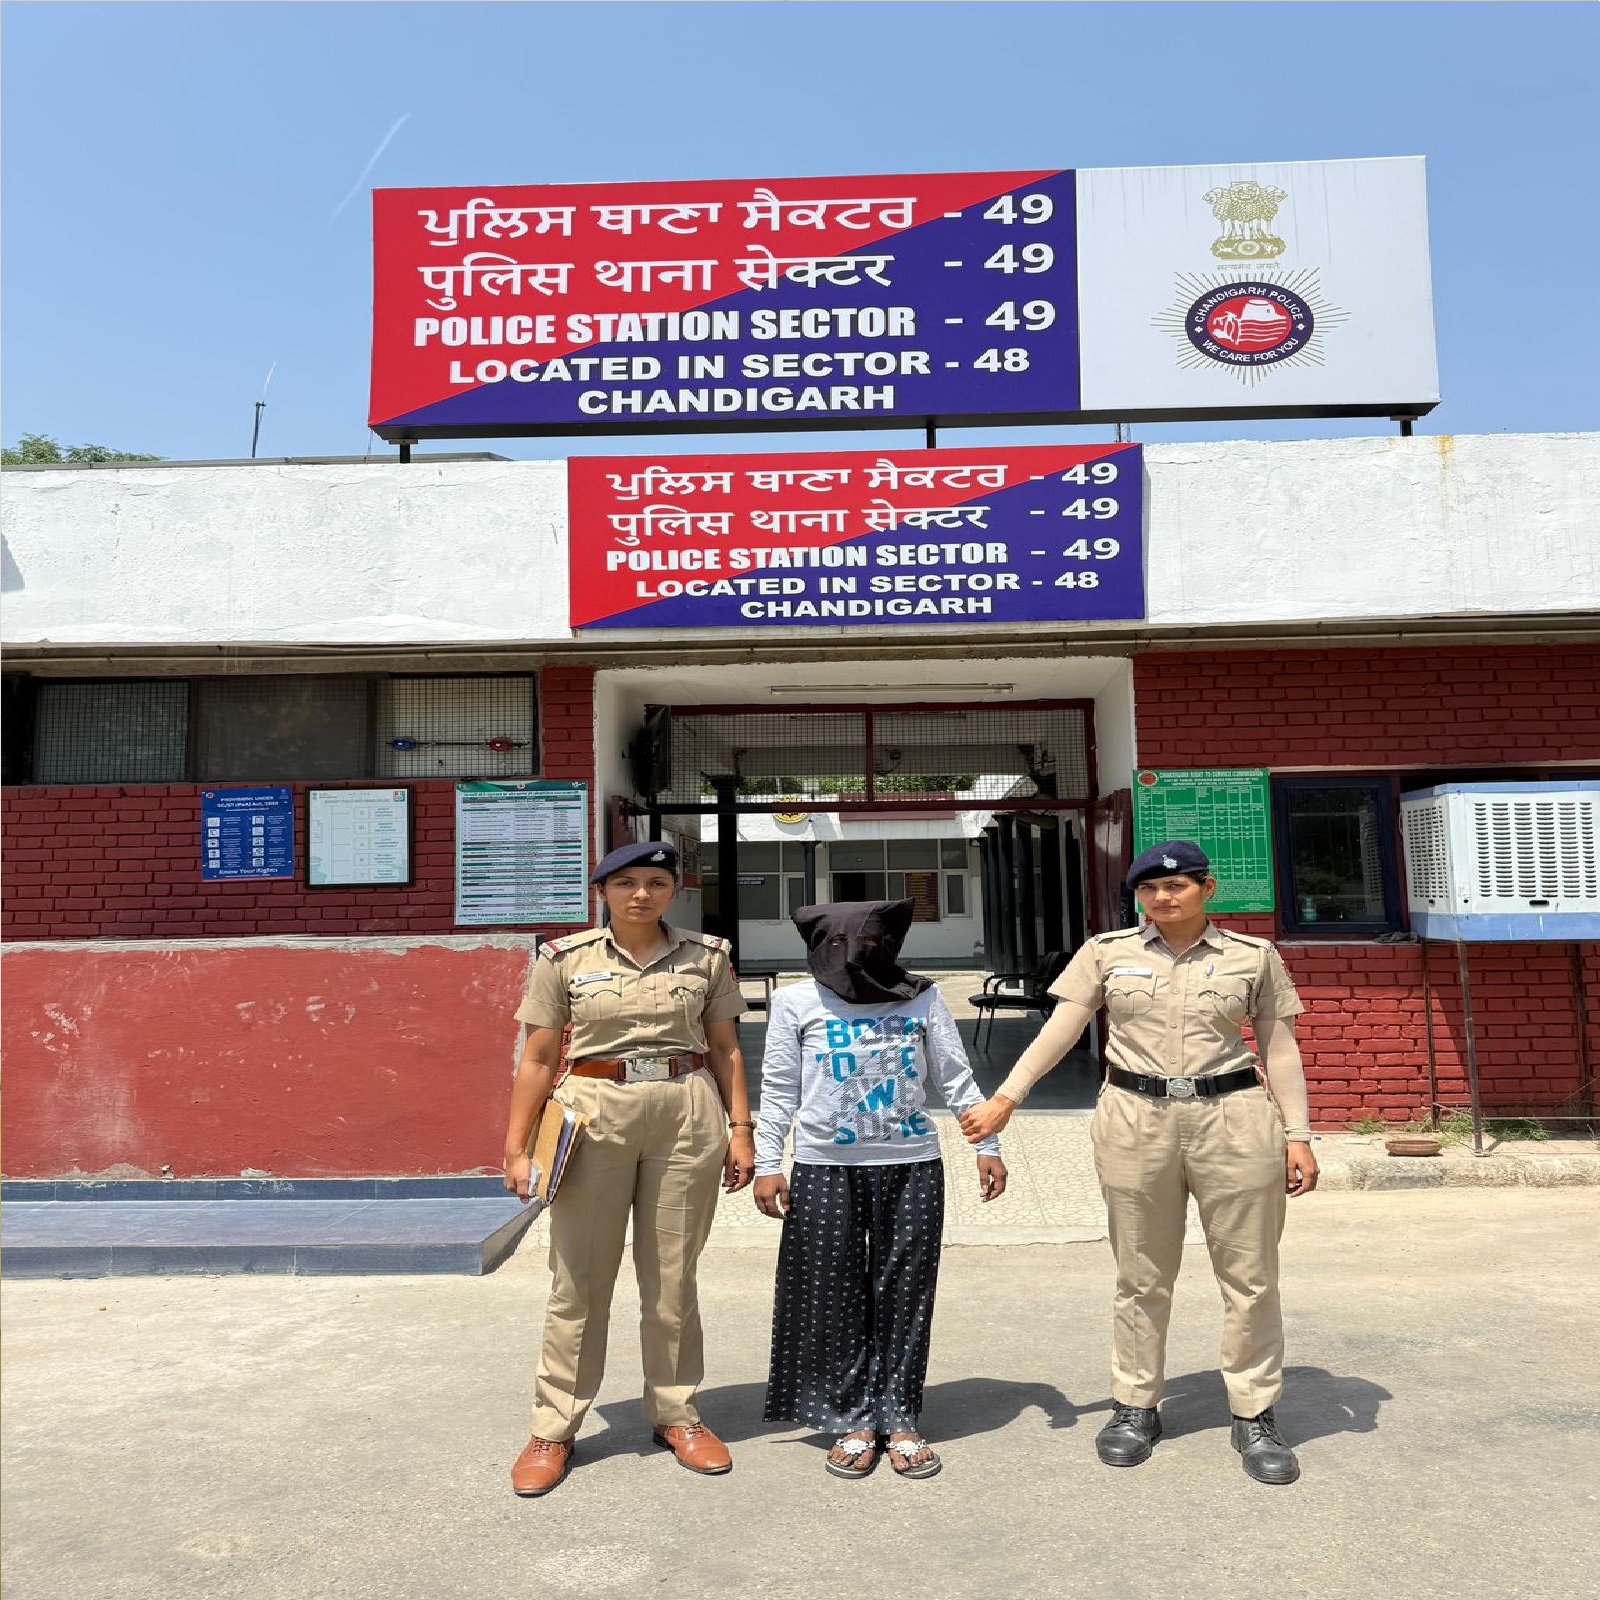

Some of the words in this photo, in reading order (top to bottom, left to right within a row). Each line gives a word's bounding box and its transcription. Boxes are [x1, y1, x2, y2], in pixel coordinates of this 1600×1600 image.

[418, 198, 576, 246] ਪੁਲਿਸ
[590, 203, 722, 234] ਥਾਣਾ
[737, 188, 916, 230] ਸੈਕਟਰ
[984, 194, 1053, 224] 49
[418, 252, 575, 310] पुलिस
[594, 260, 718, 292] थाना
[733, 245, 895, 291] सेक्टर
[984, 243, 1053, 273] 49
[1194, 287, 1266, 323] CHANDIGARH
[1269, 290, 1303, 321] POLICE
[414, 315, 556, 346] POLICE
[567, 311, 739, 343] STATION
[751, 307, 915, 339] SECTOR
[986, 300, 1055, 331] 49
[450, 357, 660, 383] LOCATED
[679, 356, 723, 379] IN
[741, 351, 931, 378] SECTOR
[974, 348, 1029, 372] 48
[1202, 339, 1220, 354] WE
[1219, 349, 1251, 362] CARE
[1254, 349, 1279, 362] FOR
[1275, 337, 1299, 354] YOU
[579, 386, 893, 414] CHANDIGARH
[606, 466, 734, 500] ਪੁਲਿਸ
[746, 469, 851, 492] ਥਾਣਾ
[864, 459, 1008, 489] ਸੈਕਟਰ
[1062, 463, 1117, 484] 49
[607, 504, 735, 546] पुलिस
[750, 510, 850, 533] थाना
[861, 499, 990, 532] सेक्टर
[1062, 498, 1119, 519] 49
[607, 549, 721, 571] POLICE
[729, 546, 866, 569] STATION
[876, 543, 1006, 566] SECTOR
[1063, 538, 1119, 559] 49
[637, 578, 805, 597] LOCATED
[819, 577, 855, 593] IN
[870, 574, 1020, 592] SECTOR
[1055, 572, 1099, 588] 48
[741, 597, 991, 618] CHANDIGARH
